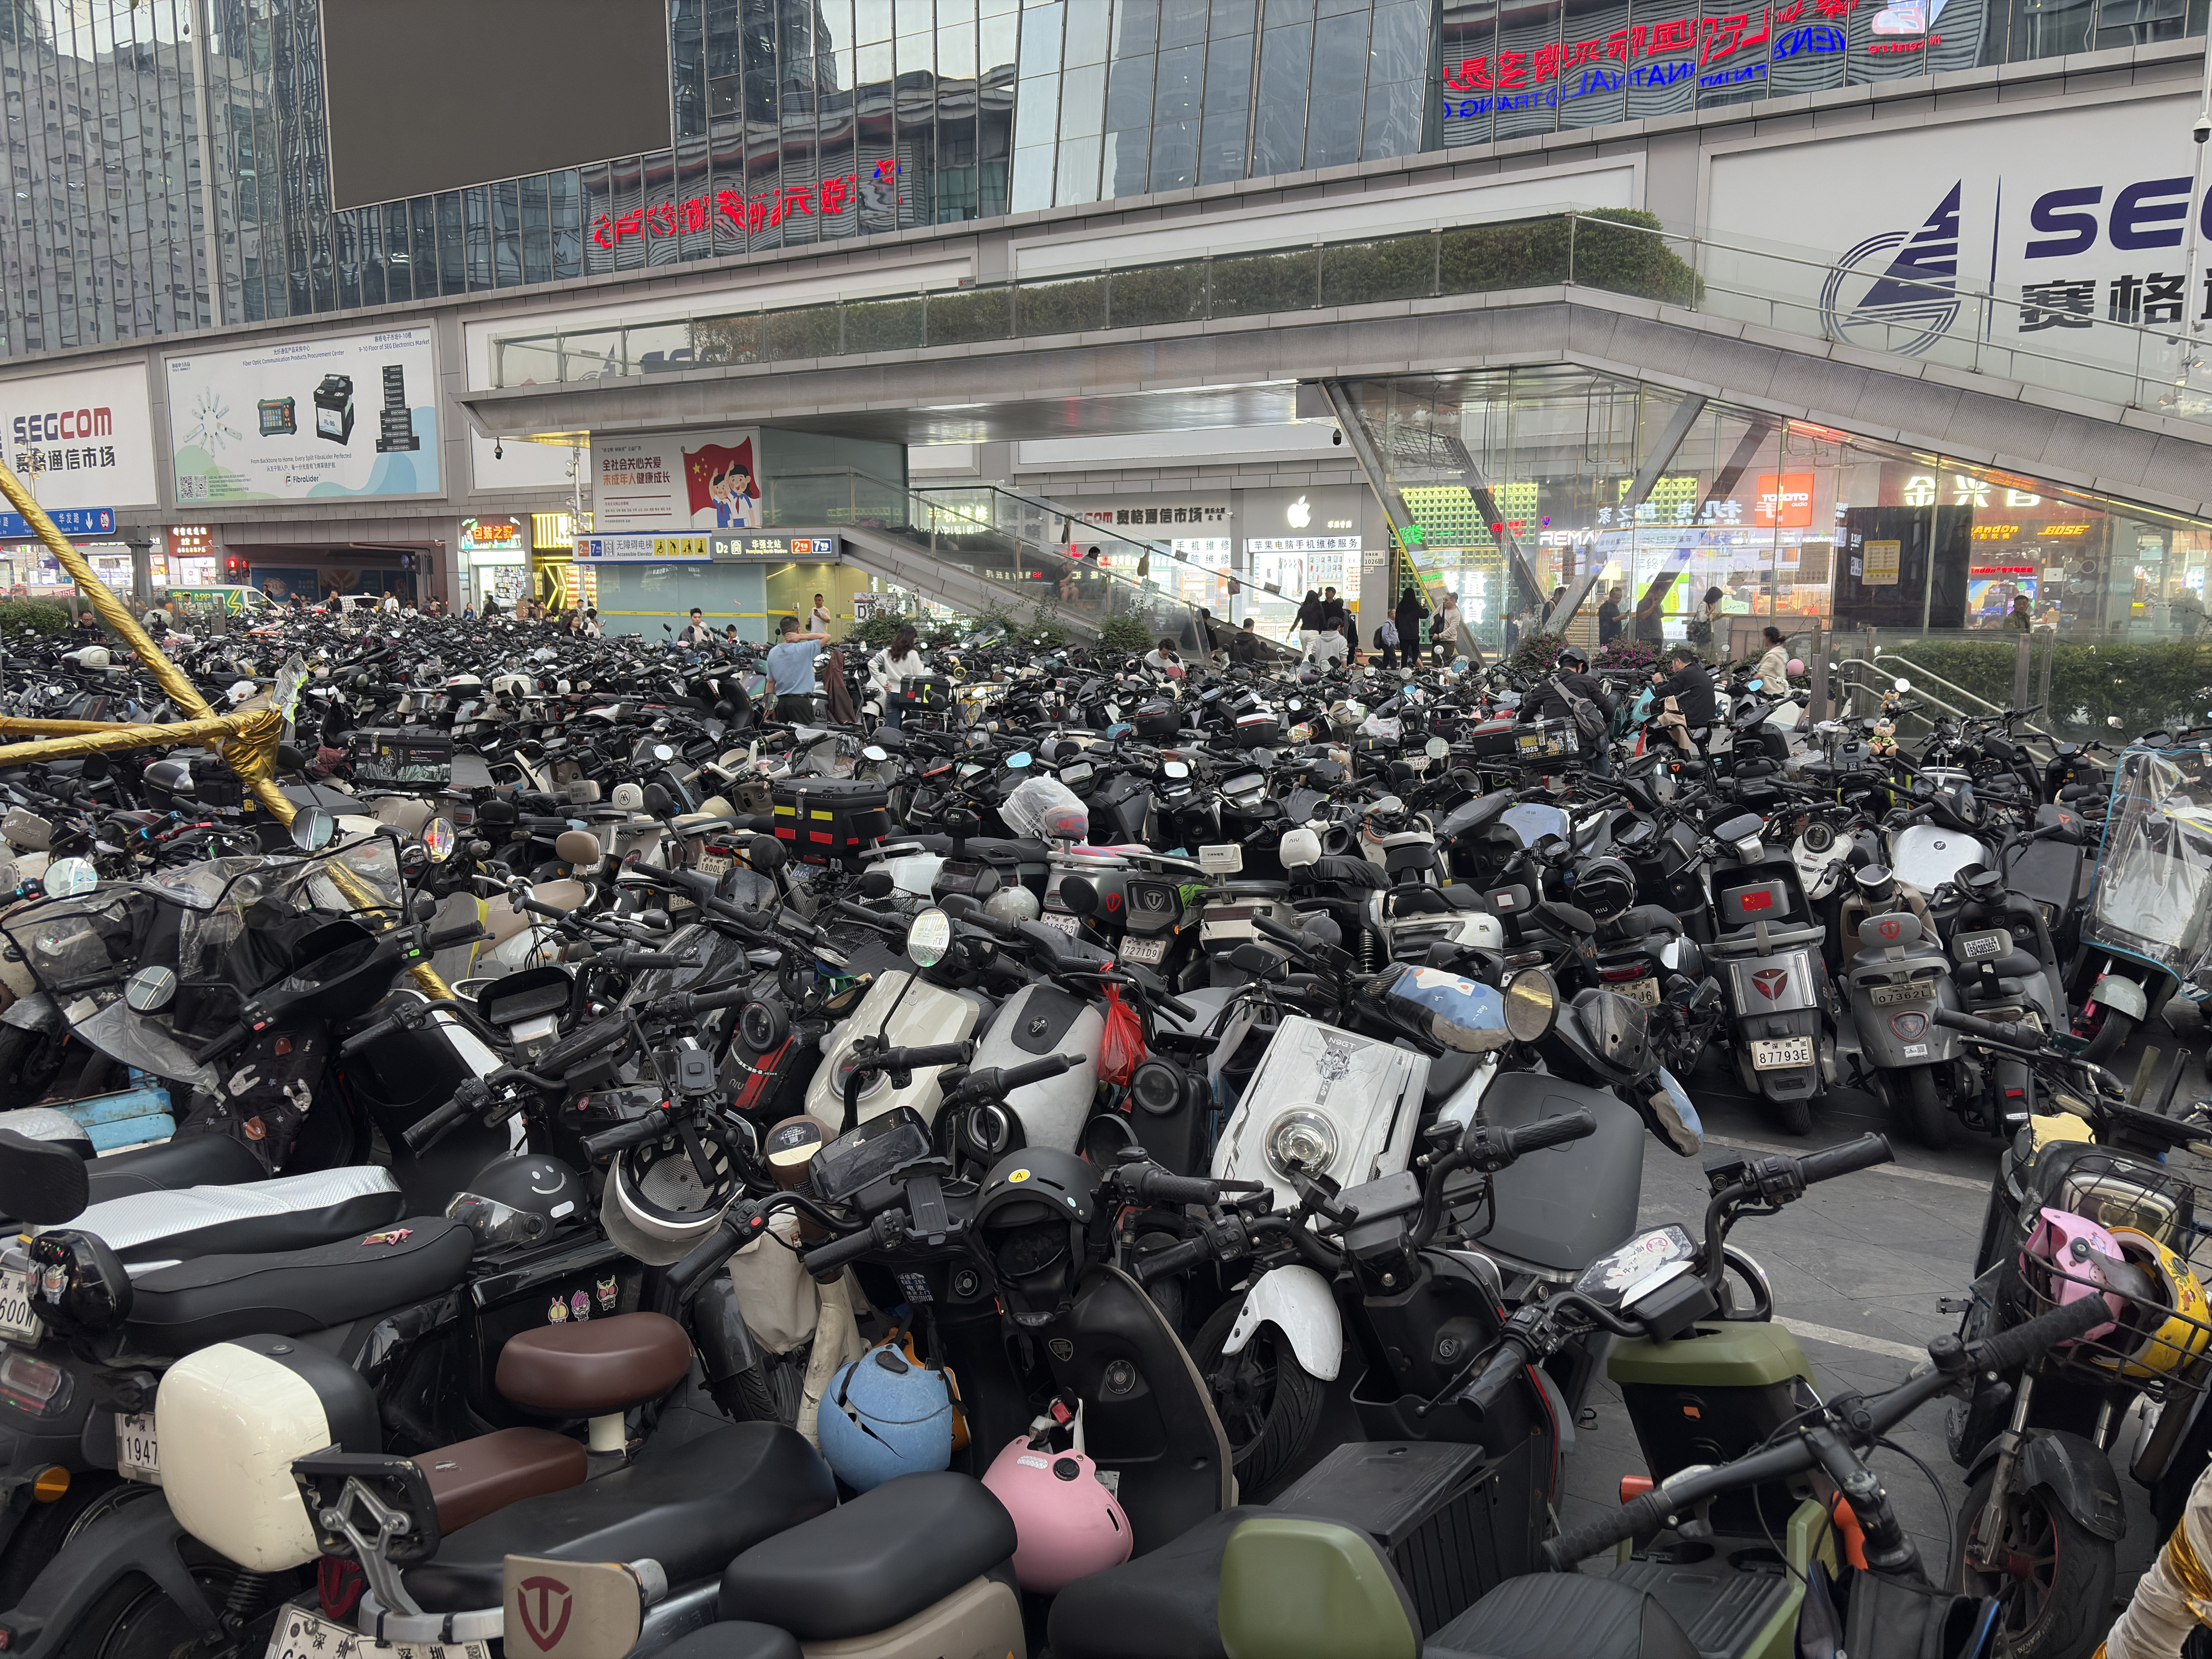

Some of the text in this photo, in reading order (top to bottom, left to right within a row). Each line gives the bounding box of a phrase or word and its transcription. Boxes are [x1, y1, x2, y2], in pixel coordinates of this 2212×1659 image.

[2025, 175, 2212, 259] SE
[2019, 268, 2212, 333] 赛格
[374, 332, 412, 342] 赛格电子市场9-10楼
[307, 351, 331, 359] Procurement
[13, 407, 112, 444] SEGCOM
[603, 456, 661, 471] 全社会关心关爱
[293, 475, 319, 483] FibraLider
[603, 471, 671, 486] 未成年人健康成长
[59, 513, 80, 524] 华发路
[927, 505, 989, 523] 手机维修
[1117, 507, 1203, 525] 赛格通信市场
[474, 525, 513, 540] 包装之家
[2038, 525, 2090, 535] BOSE
[617, 539, 653, 550] 无障碍电梯
[716, 542, 728, 554] D2
[752, 539, 781, 549] 华强北站
[1176, 540, 1229, 551] 手机维修
[1254, 538, 1358, 550] 苹果电脑手机维修服务
[1178, 554, 1229, 565] 脑维修
[701, 863, 726, 874] 1800L7
[1125, 946, 1157, 958] 7271D9
[1879, 990, 1928, 1003] 07362L
[1328, 1037, 1357, 1049] N9GT
[1759, 1049, 1809, 1063] 87793E
[729, 1078, 744, 1091] niu
[1, 1277, 25, 1293] 深圳
[127, 1436, 158, 1465] 1947
